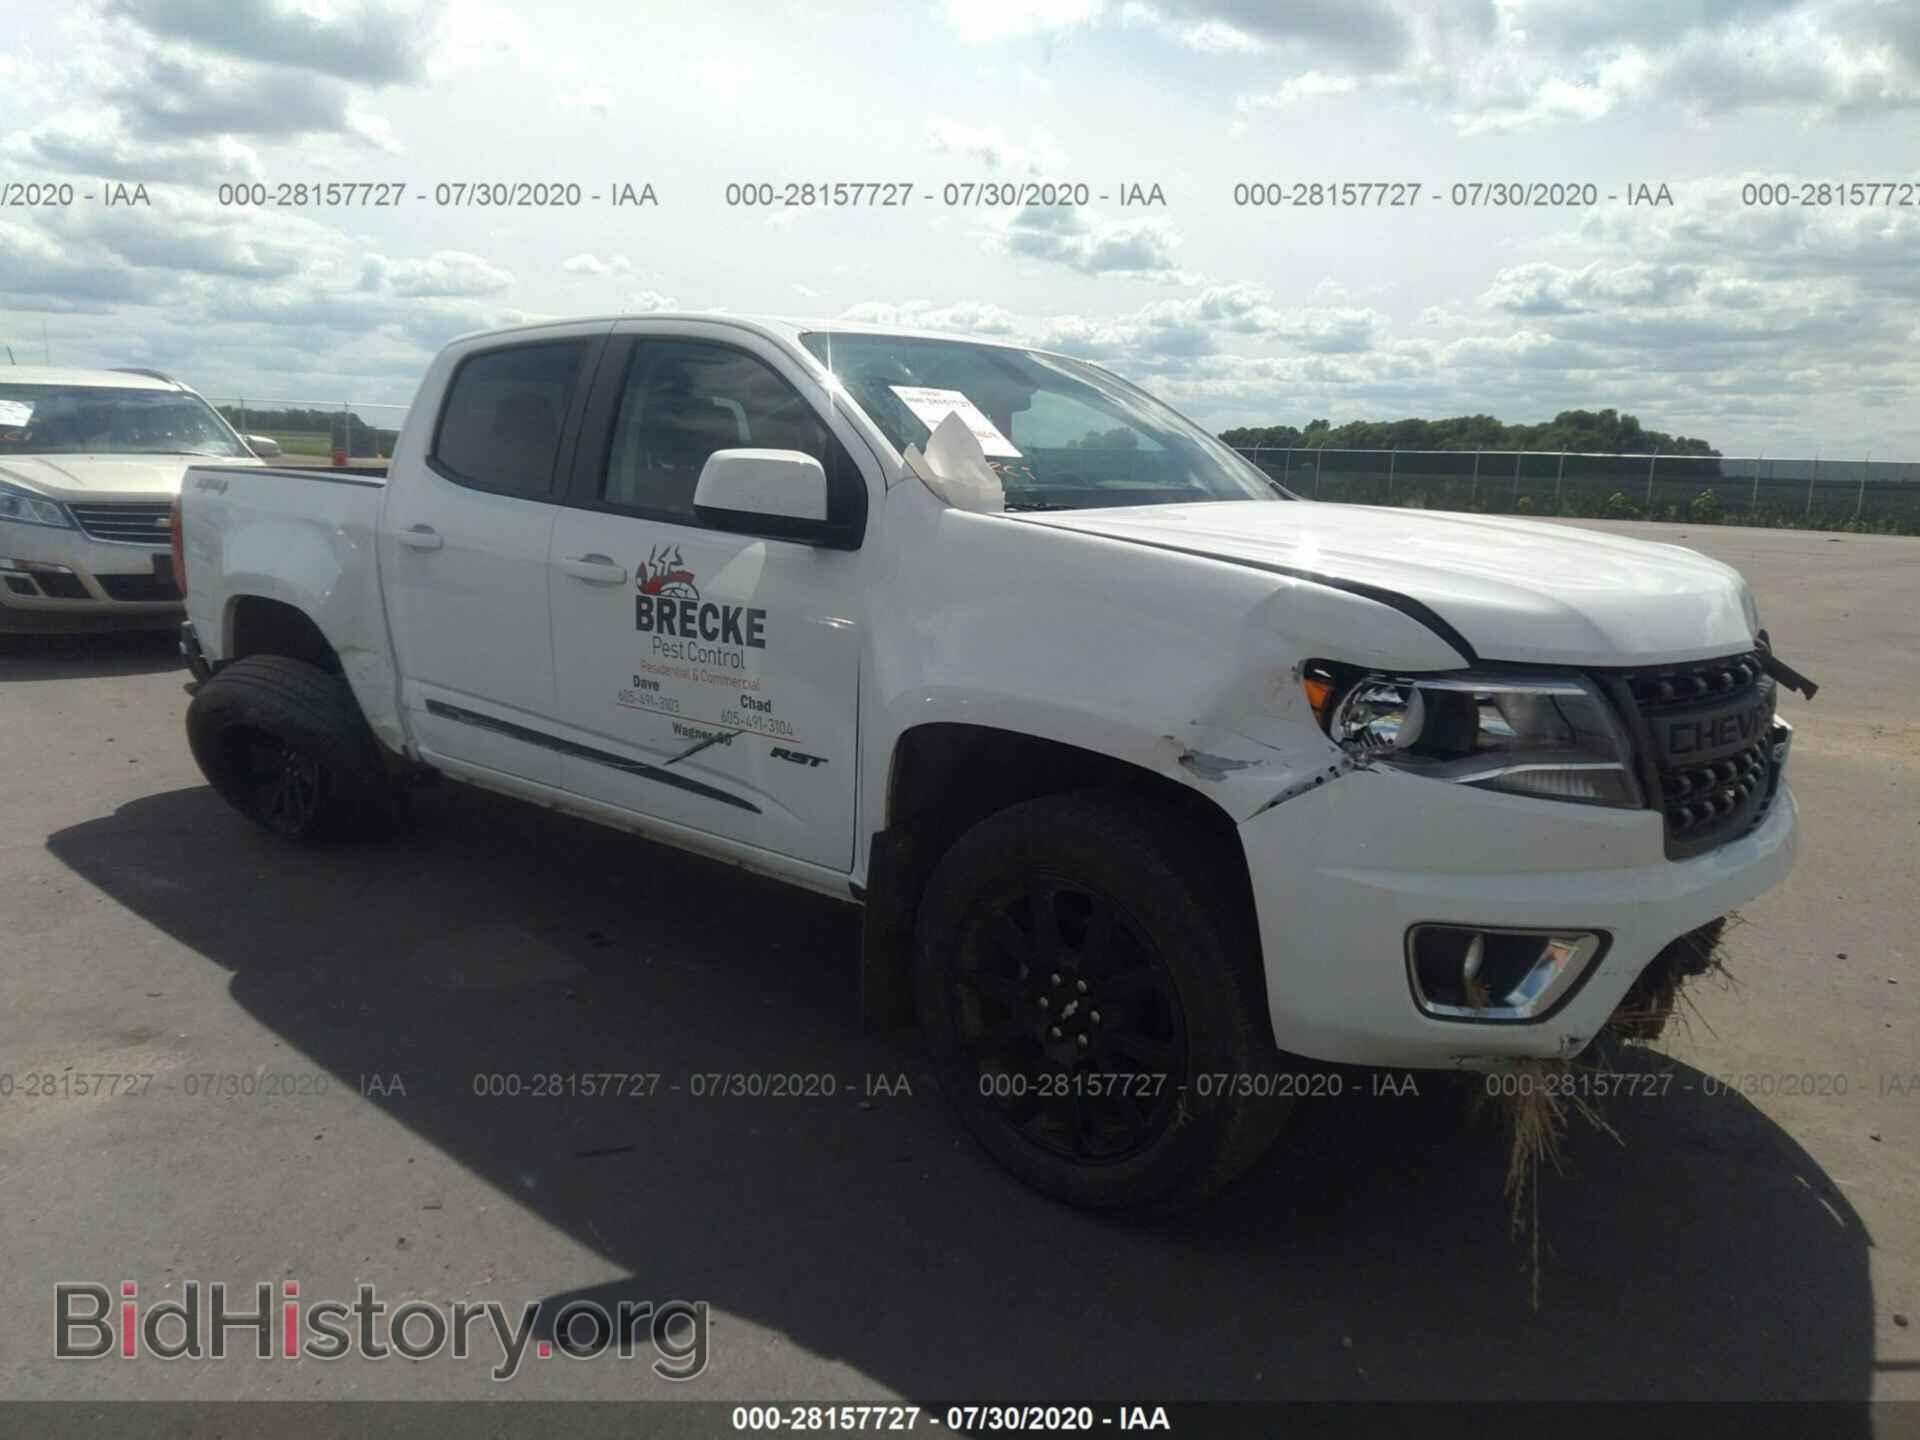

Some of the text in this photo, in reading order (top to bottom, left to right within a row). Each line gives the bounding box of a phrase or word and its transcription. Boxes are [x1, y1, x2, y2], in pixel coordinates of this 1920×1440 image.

[635, 594, 767, 649] BRECKE
[652, 636, 745, 669] Pest Control
[633, 674, 660, 692] Dave
[740, 694, 772, 713] Chad
[720, 709, 794, 736] 605-491-3104
[769, 746, 829, 768] RST
